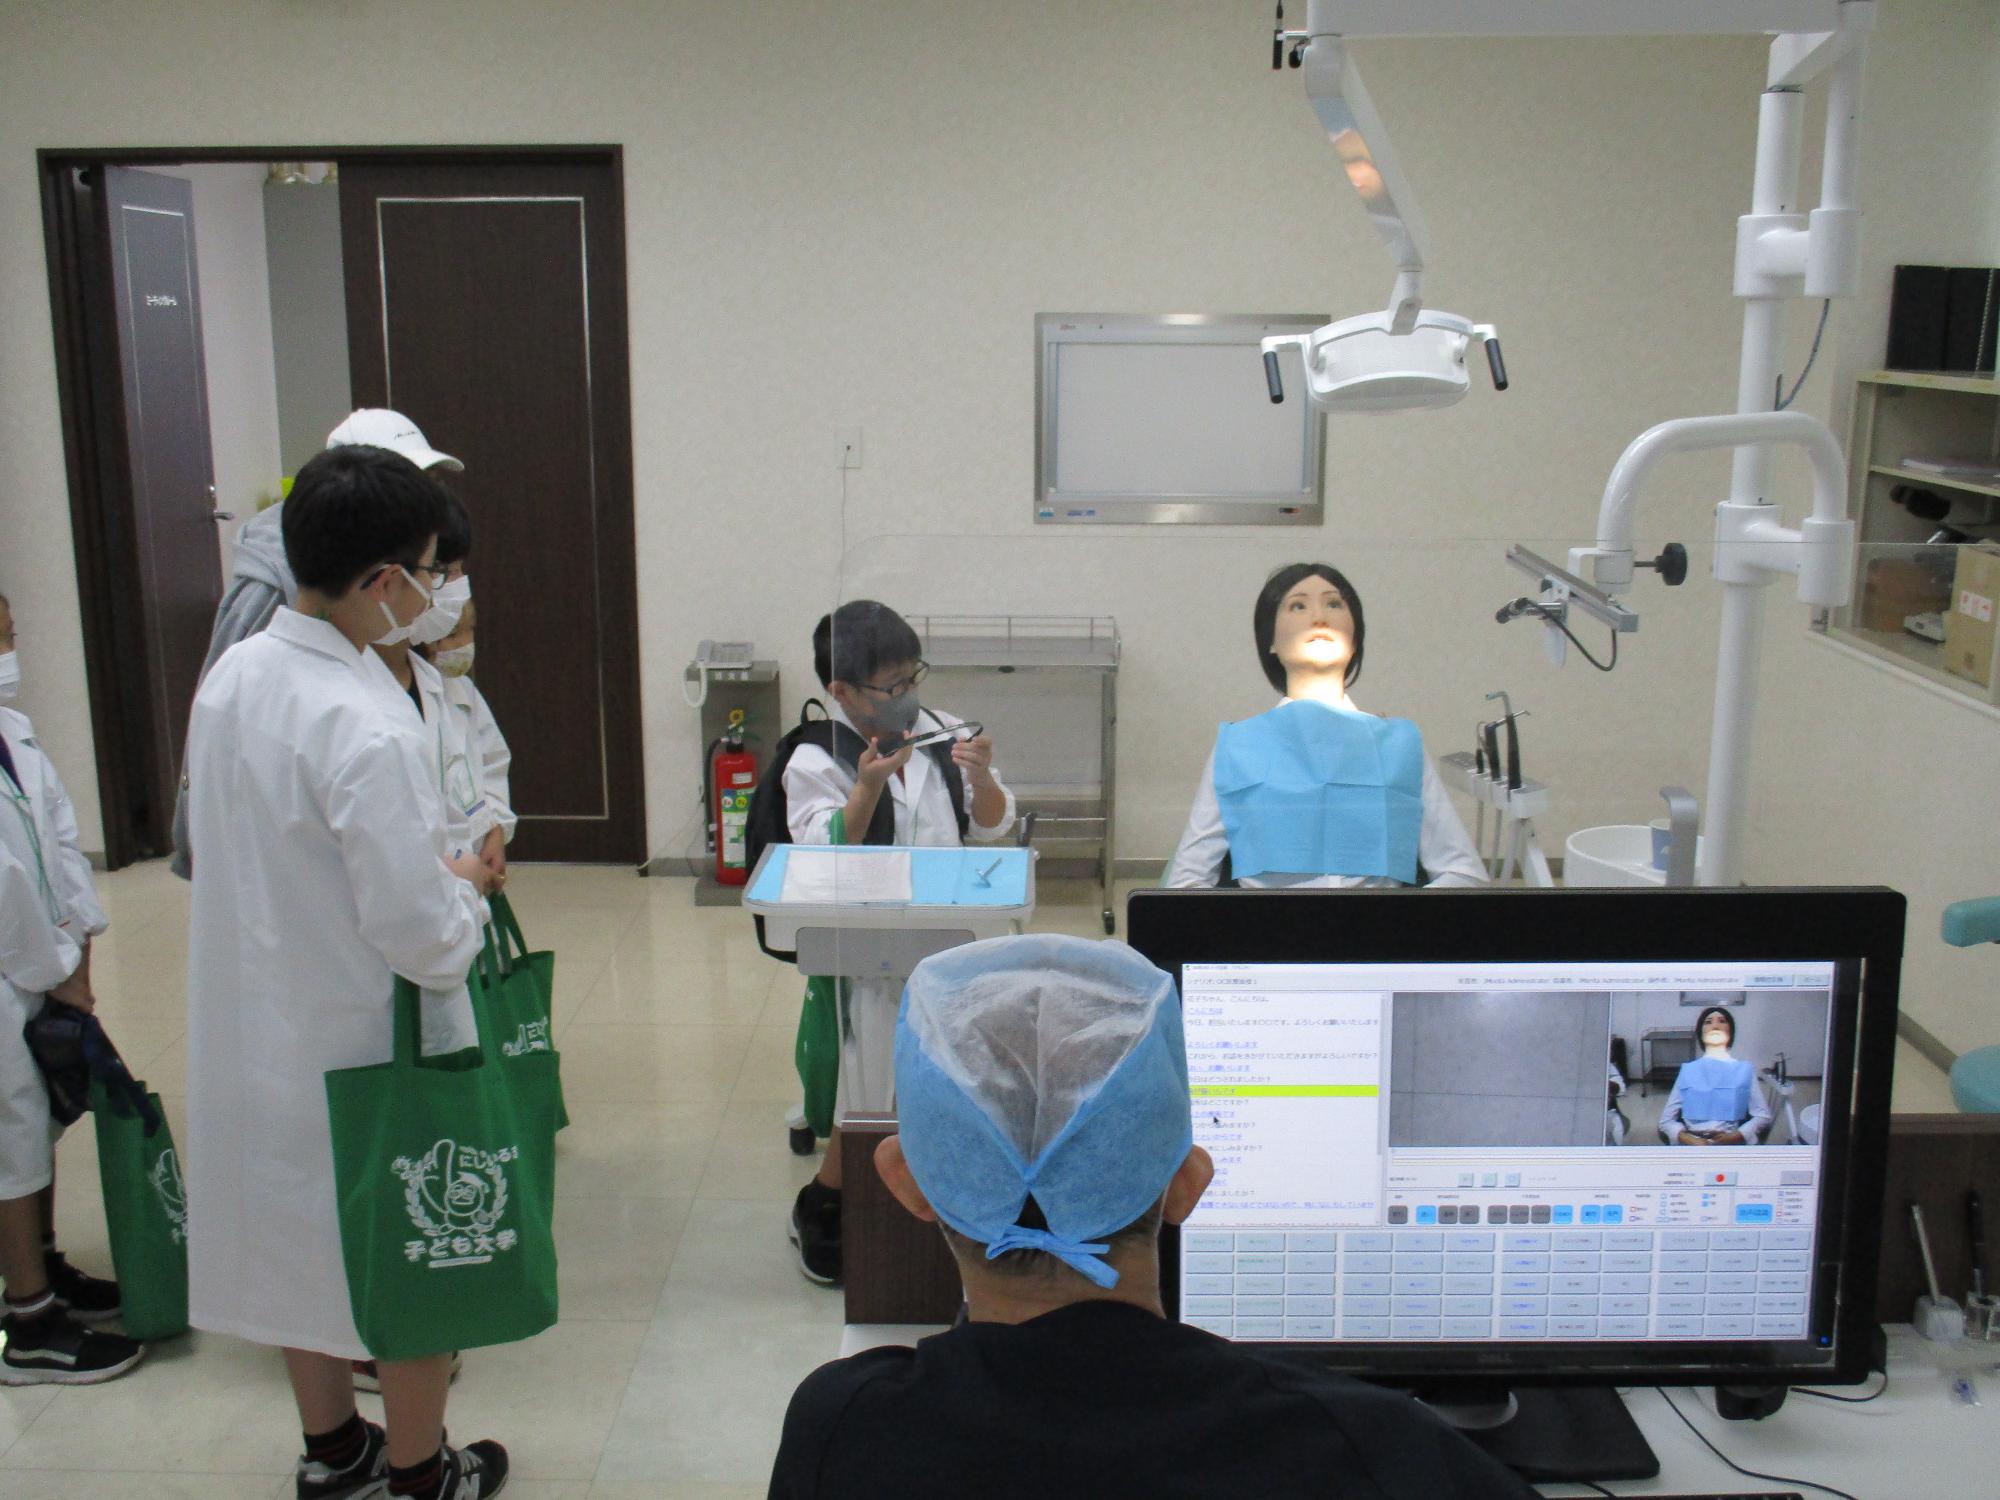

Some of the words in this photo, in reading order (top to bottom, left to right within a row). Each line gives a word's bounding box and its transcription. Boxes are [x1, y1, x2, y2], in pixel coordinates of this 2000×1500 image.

[404, 1229, 518, 1262] 子ども大学
